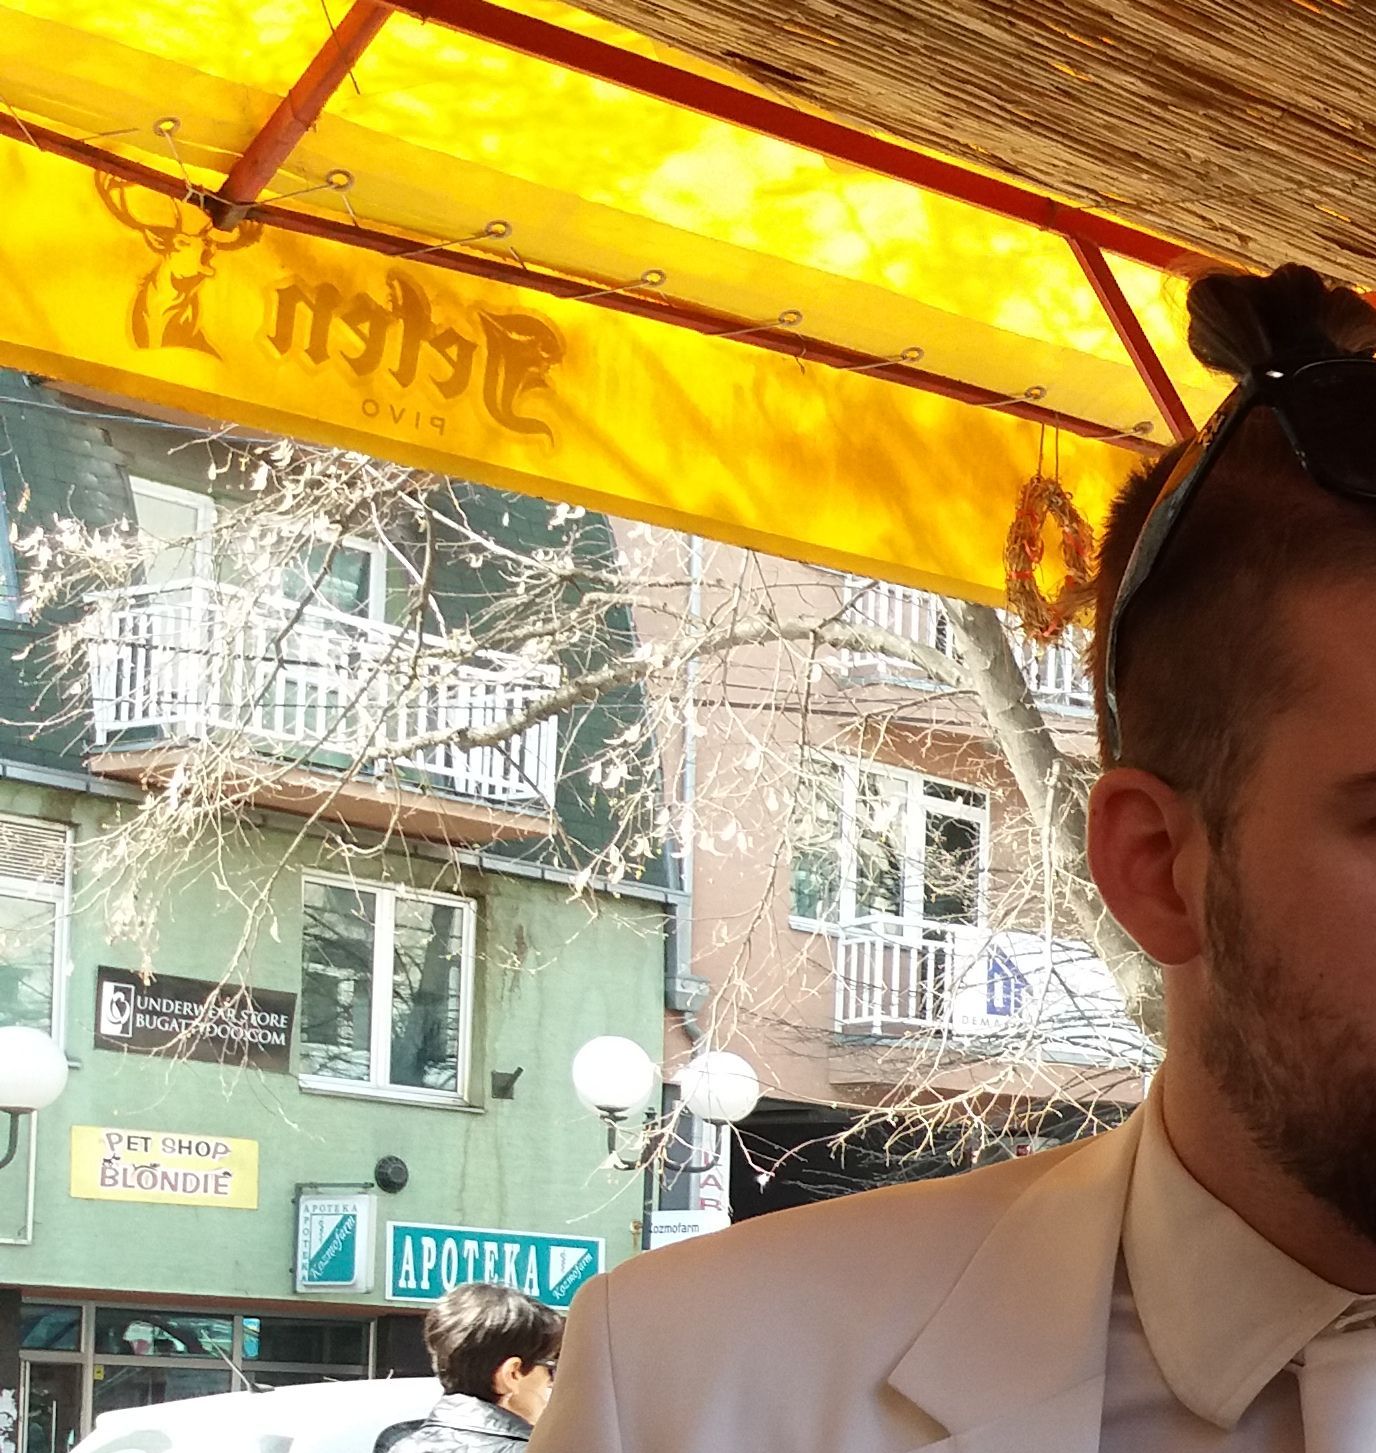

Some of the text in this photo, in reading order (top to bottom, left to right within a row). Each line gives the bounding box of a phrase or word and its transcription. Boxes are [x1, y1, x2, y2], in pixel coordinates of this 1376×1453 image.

[136, 996, 289, 1029] UNDERWEAR STORE
[105, 1132, 231, 1160] PET SHOP
[100, 1166, 231, 1195] BLONDIE
[303, 1204, 358, 1213] APOTEKA
[399, 1235, 540, 1297] APOTEKA
